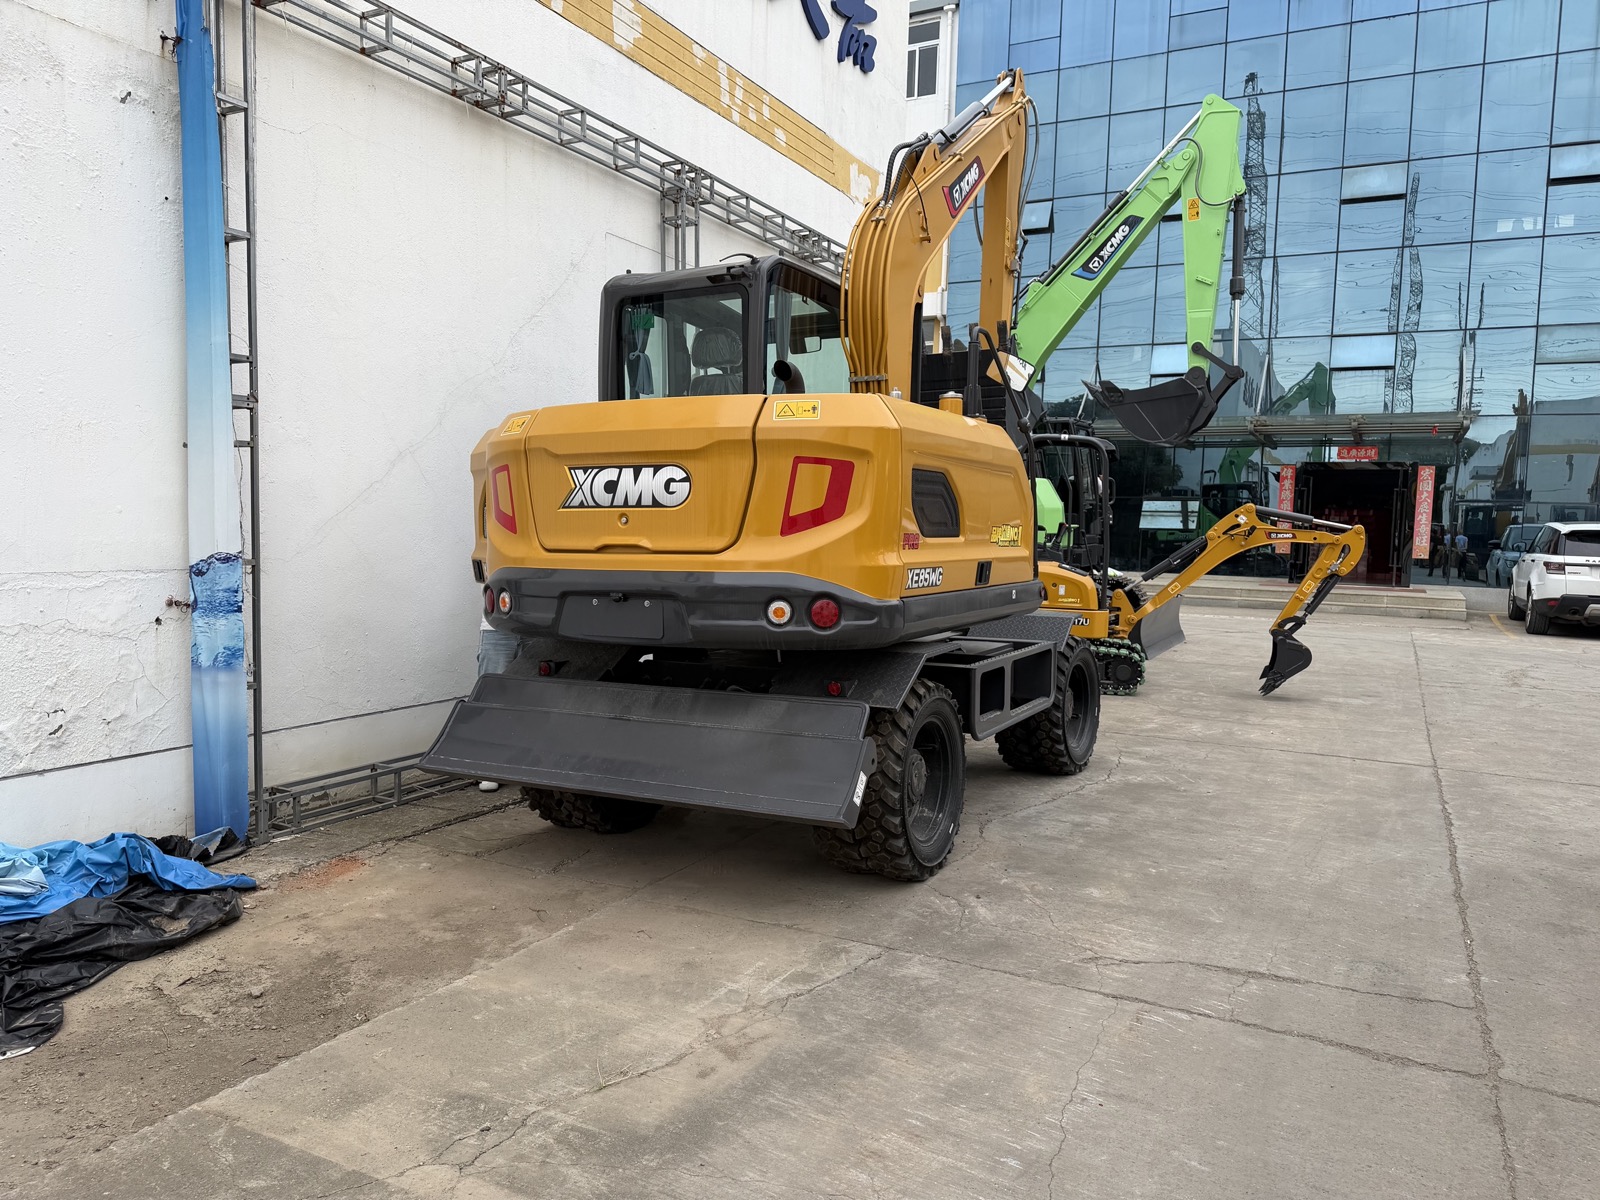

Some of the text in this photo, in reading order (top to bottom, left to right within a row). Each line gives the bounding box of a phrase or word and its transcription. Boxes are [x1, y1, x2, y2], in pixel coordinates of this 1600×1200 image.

[960, 162, 979, 200] XCMG
[1099, 224, 1130, 262] XCMG
[564, 465, 690, 507] XCMG
[905, 567, 943, 589] XE85WG
[1074, 617, 1090, 626] 17U
